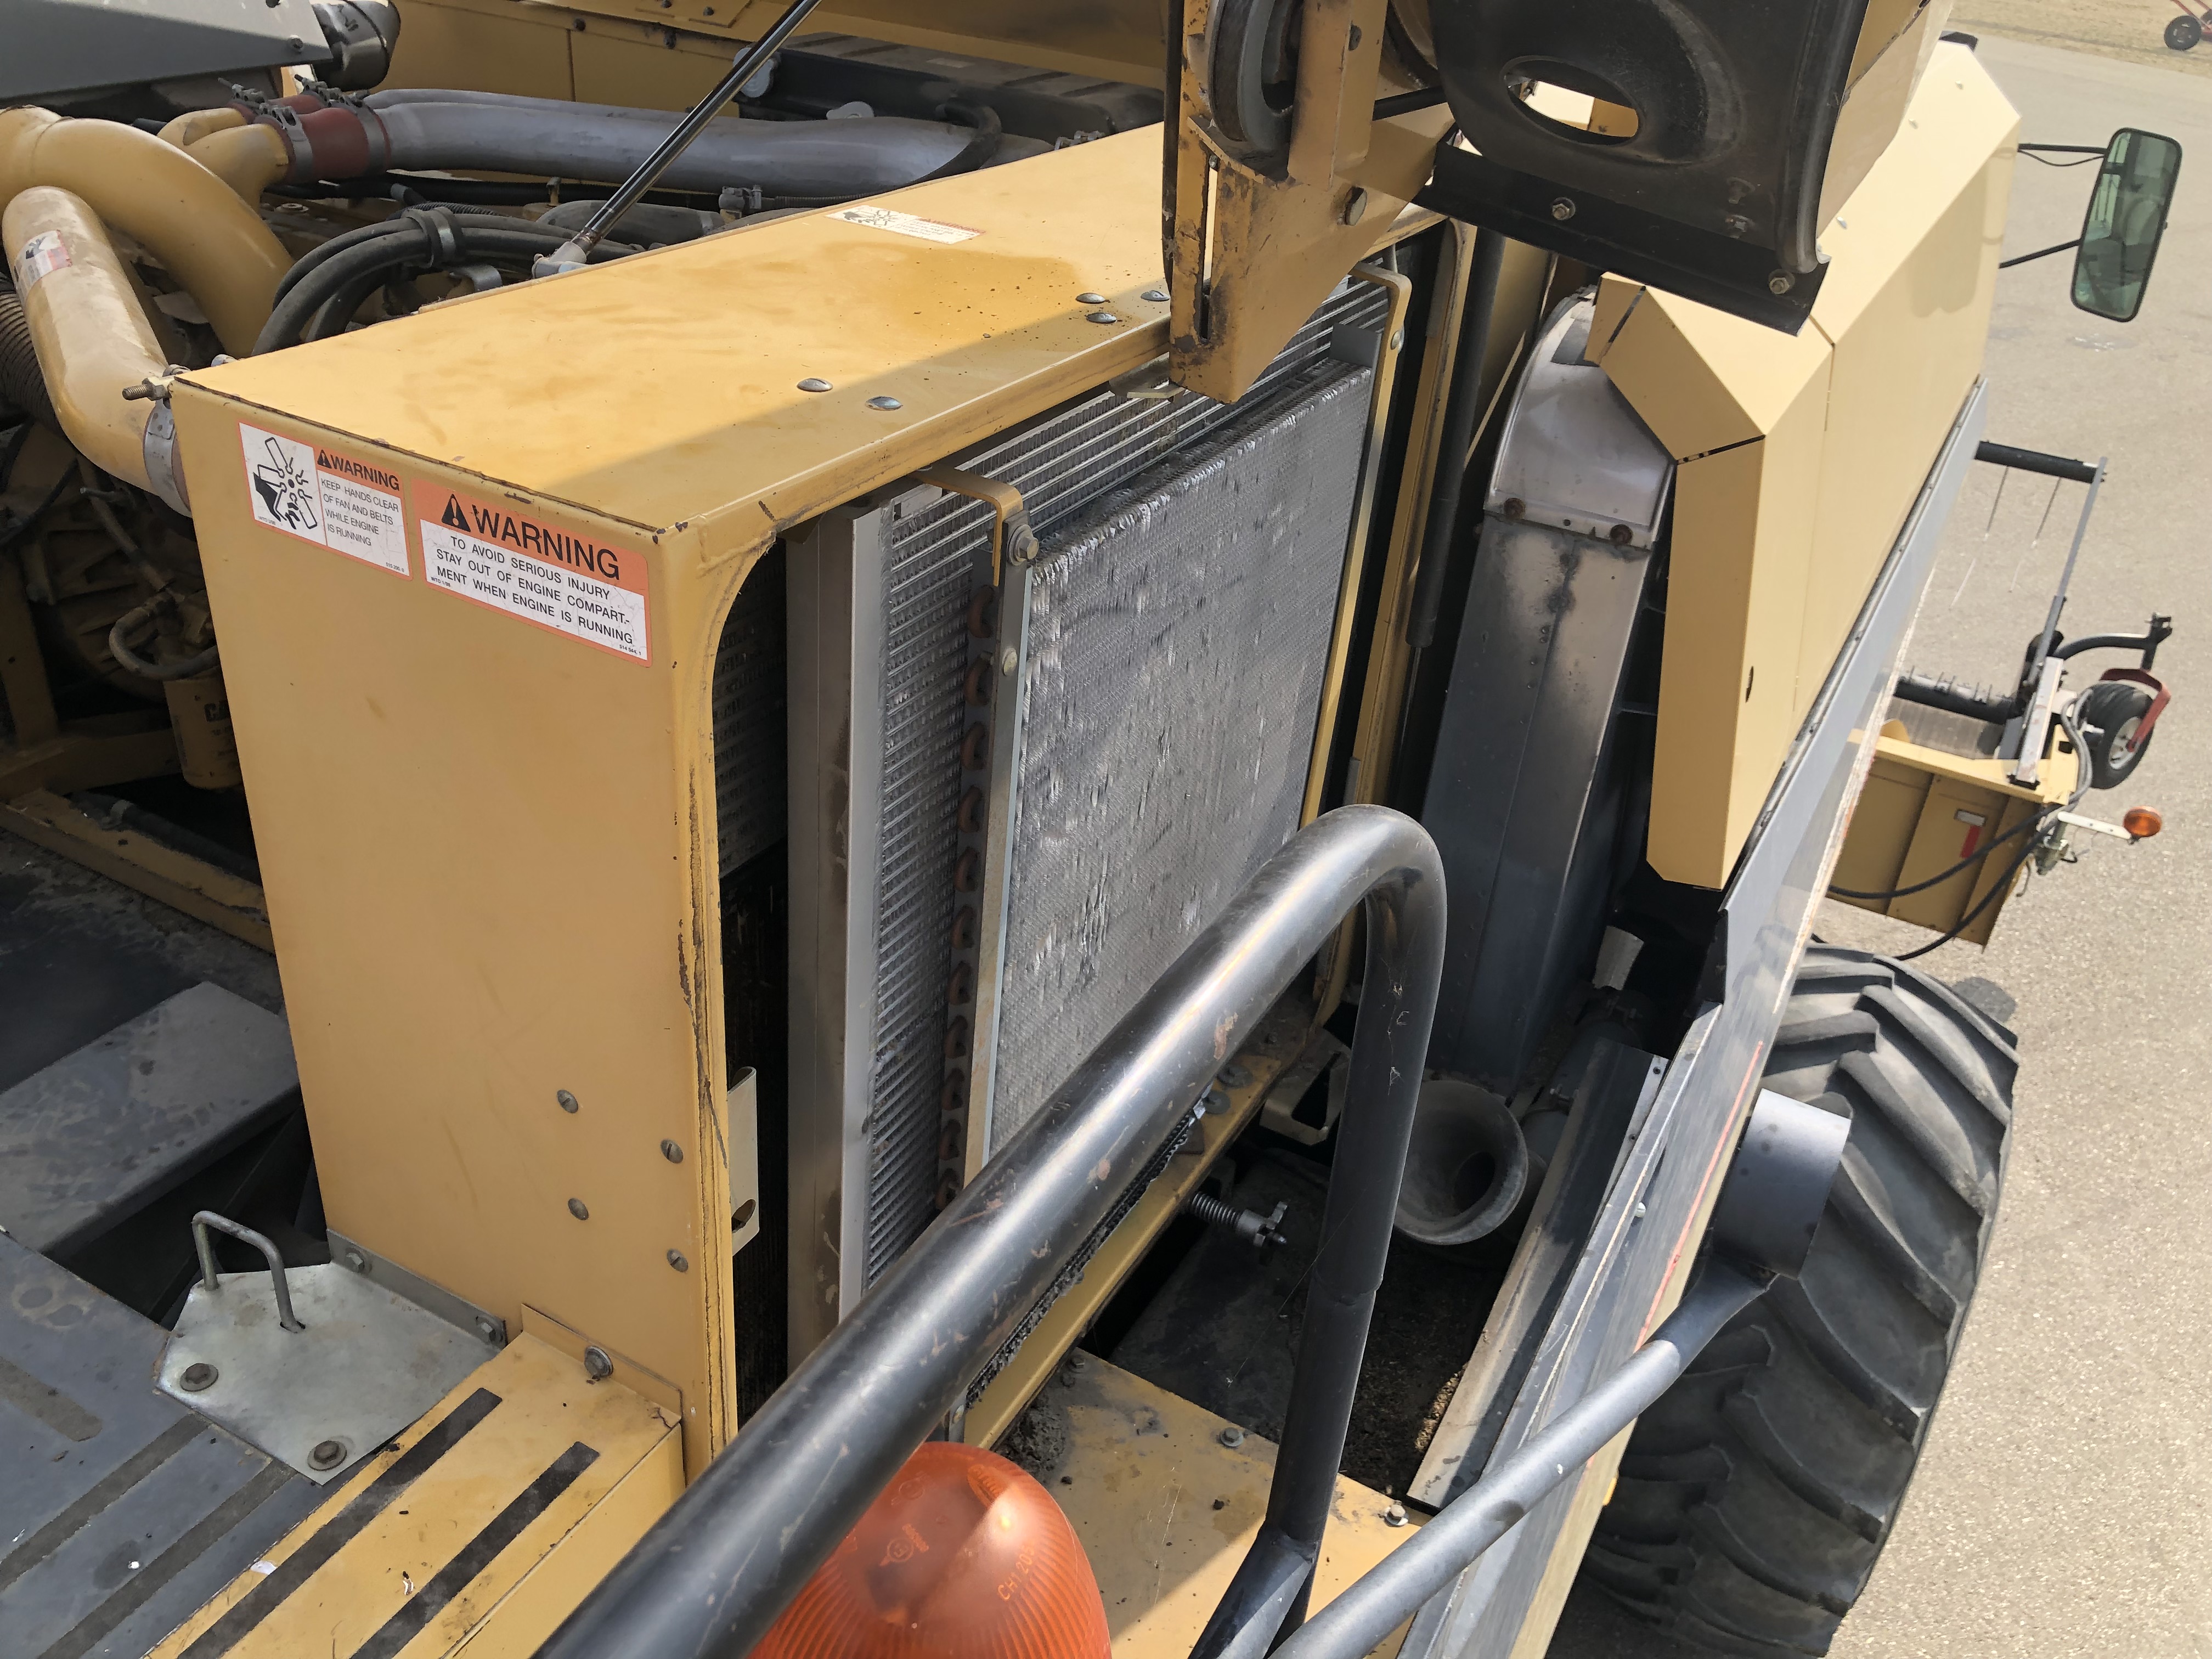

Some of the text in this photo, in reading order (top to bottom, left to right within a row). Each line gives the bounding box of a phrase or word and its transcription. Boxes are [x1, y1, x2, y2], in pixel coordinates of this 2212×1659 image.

[330, 454, 400, 492] WARNING
[321, 478, 399, 512] KEEP HANDS CLEAR
[323, 494, 394, 525] OF FAN AND BELTS
[325, 508, 380, 535] WHILE ENGINE
[328, 523, 372, 546] IS RUNNING
[471, 504, 620, 580] WARNING
[437, 549, 462, 566] STAY
[468, 560, 491, 576] OUT
[497, 570, 512, 583] OF
[518, 577, 561, 602] ENGINE
[450, 535, 610, 600] TO AVOID SERIOUS INJURY
[437, 566, 633, 645] MENT WHEN ENGINE IS RUNNING
